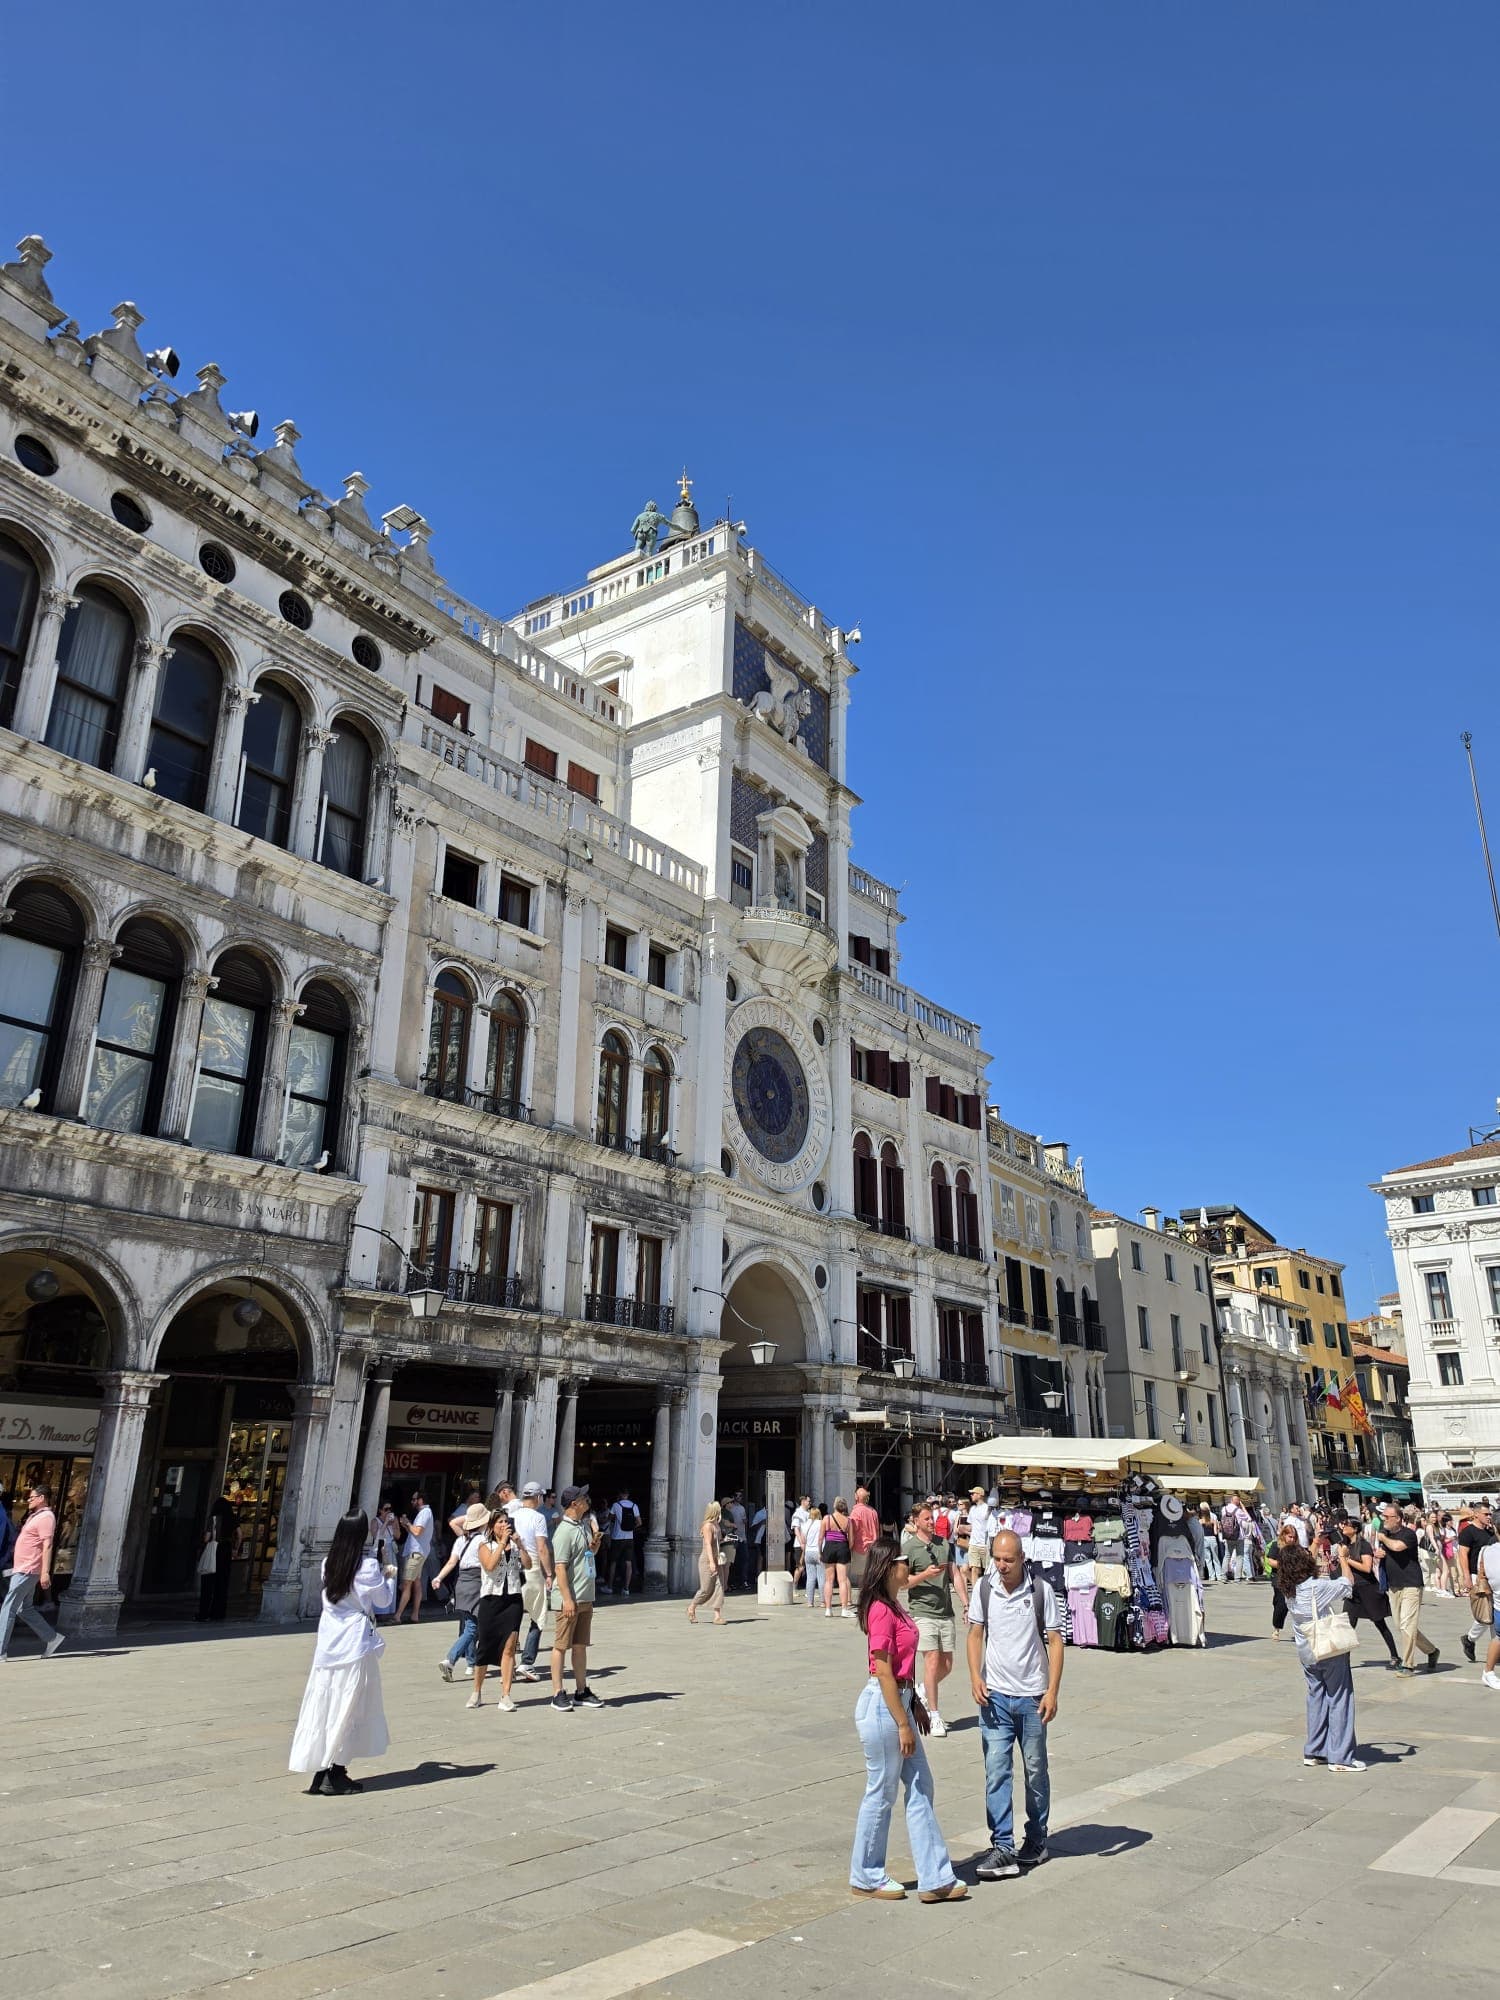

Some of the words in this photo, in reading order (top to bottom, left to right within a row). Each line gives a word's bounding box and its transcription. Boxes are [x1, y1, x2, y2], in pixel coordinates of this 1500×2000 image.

[183, 1191, 230, 1211] PIAZZA
[236, 1201, 263, 1215] SAN
[266, 1206, 310, 1223] MARCO
[427, 1408, 480, 1425] CHANGE
[580, 1422, 641, 1438] AMERICAN
[753, 1420, 781, 1434] BAR
